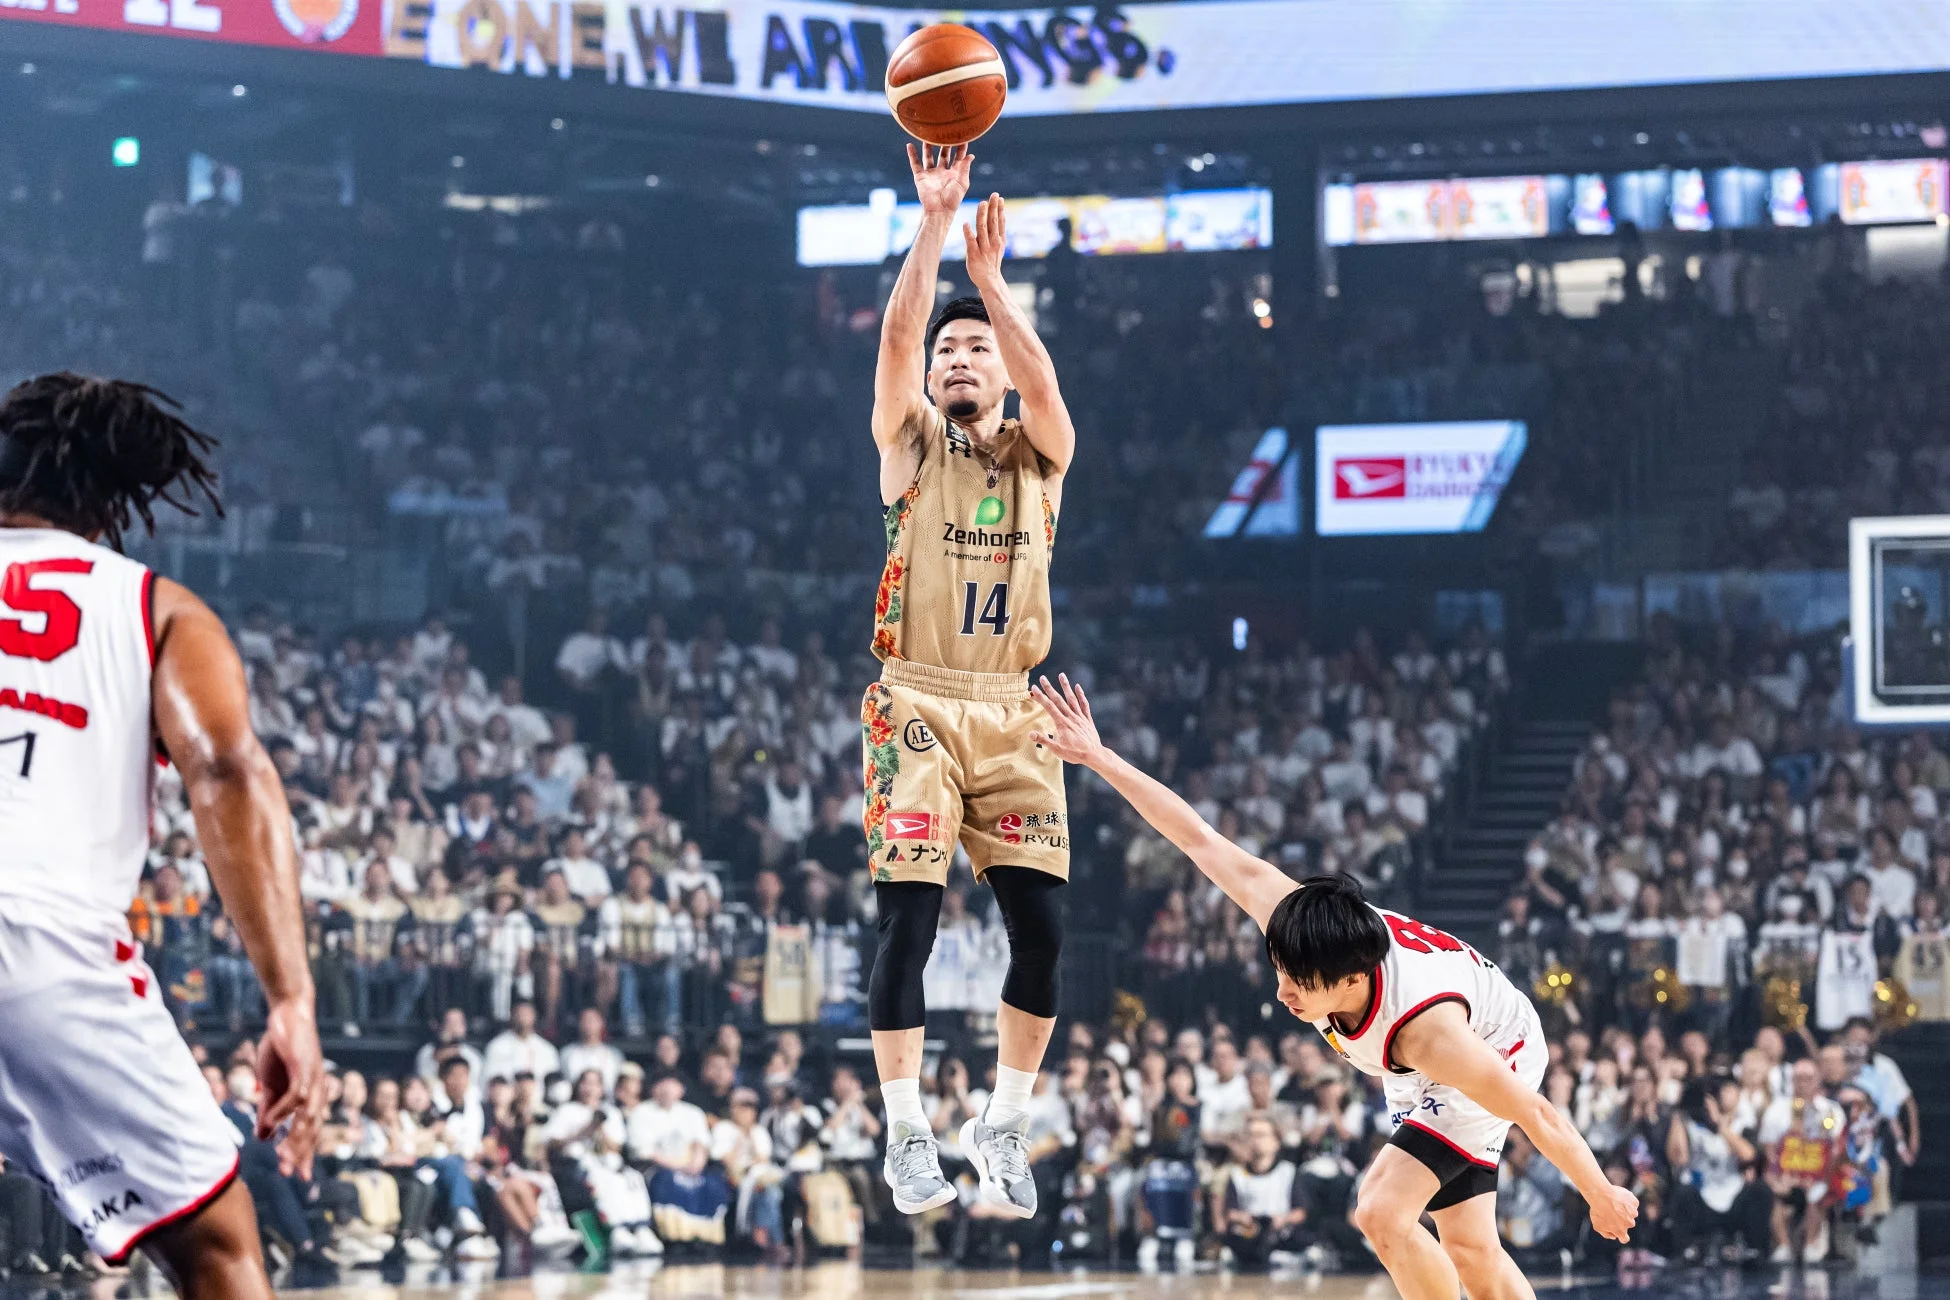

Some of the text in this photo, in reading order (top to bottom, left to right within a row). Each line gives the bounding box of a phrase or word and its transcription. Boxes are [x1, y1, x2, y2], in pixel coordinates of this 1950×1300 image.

[942, 522, 1030, 548] Zenhoren
[944, 549, 950, 557] A
[951, 551, 982, 561] member
[983, 553, 992, 562] of
[960, 581, 1011, 637] 14
